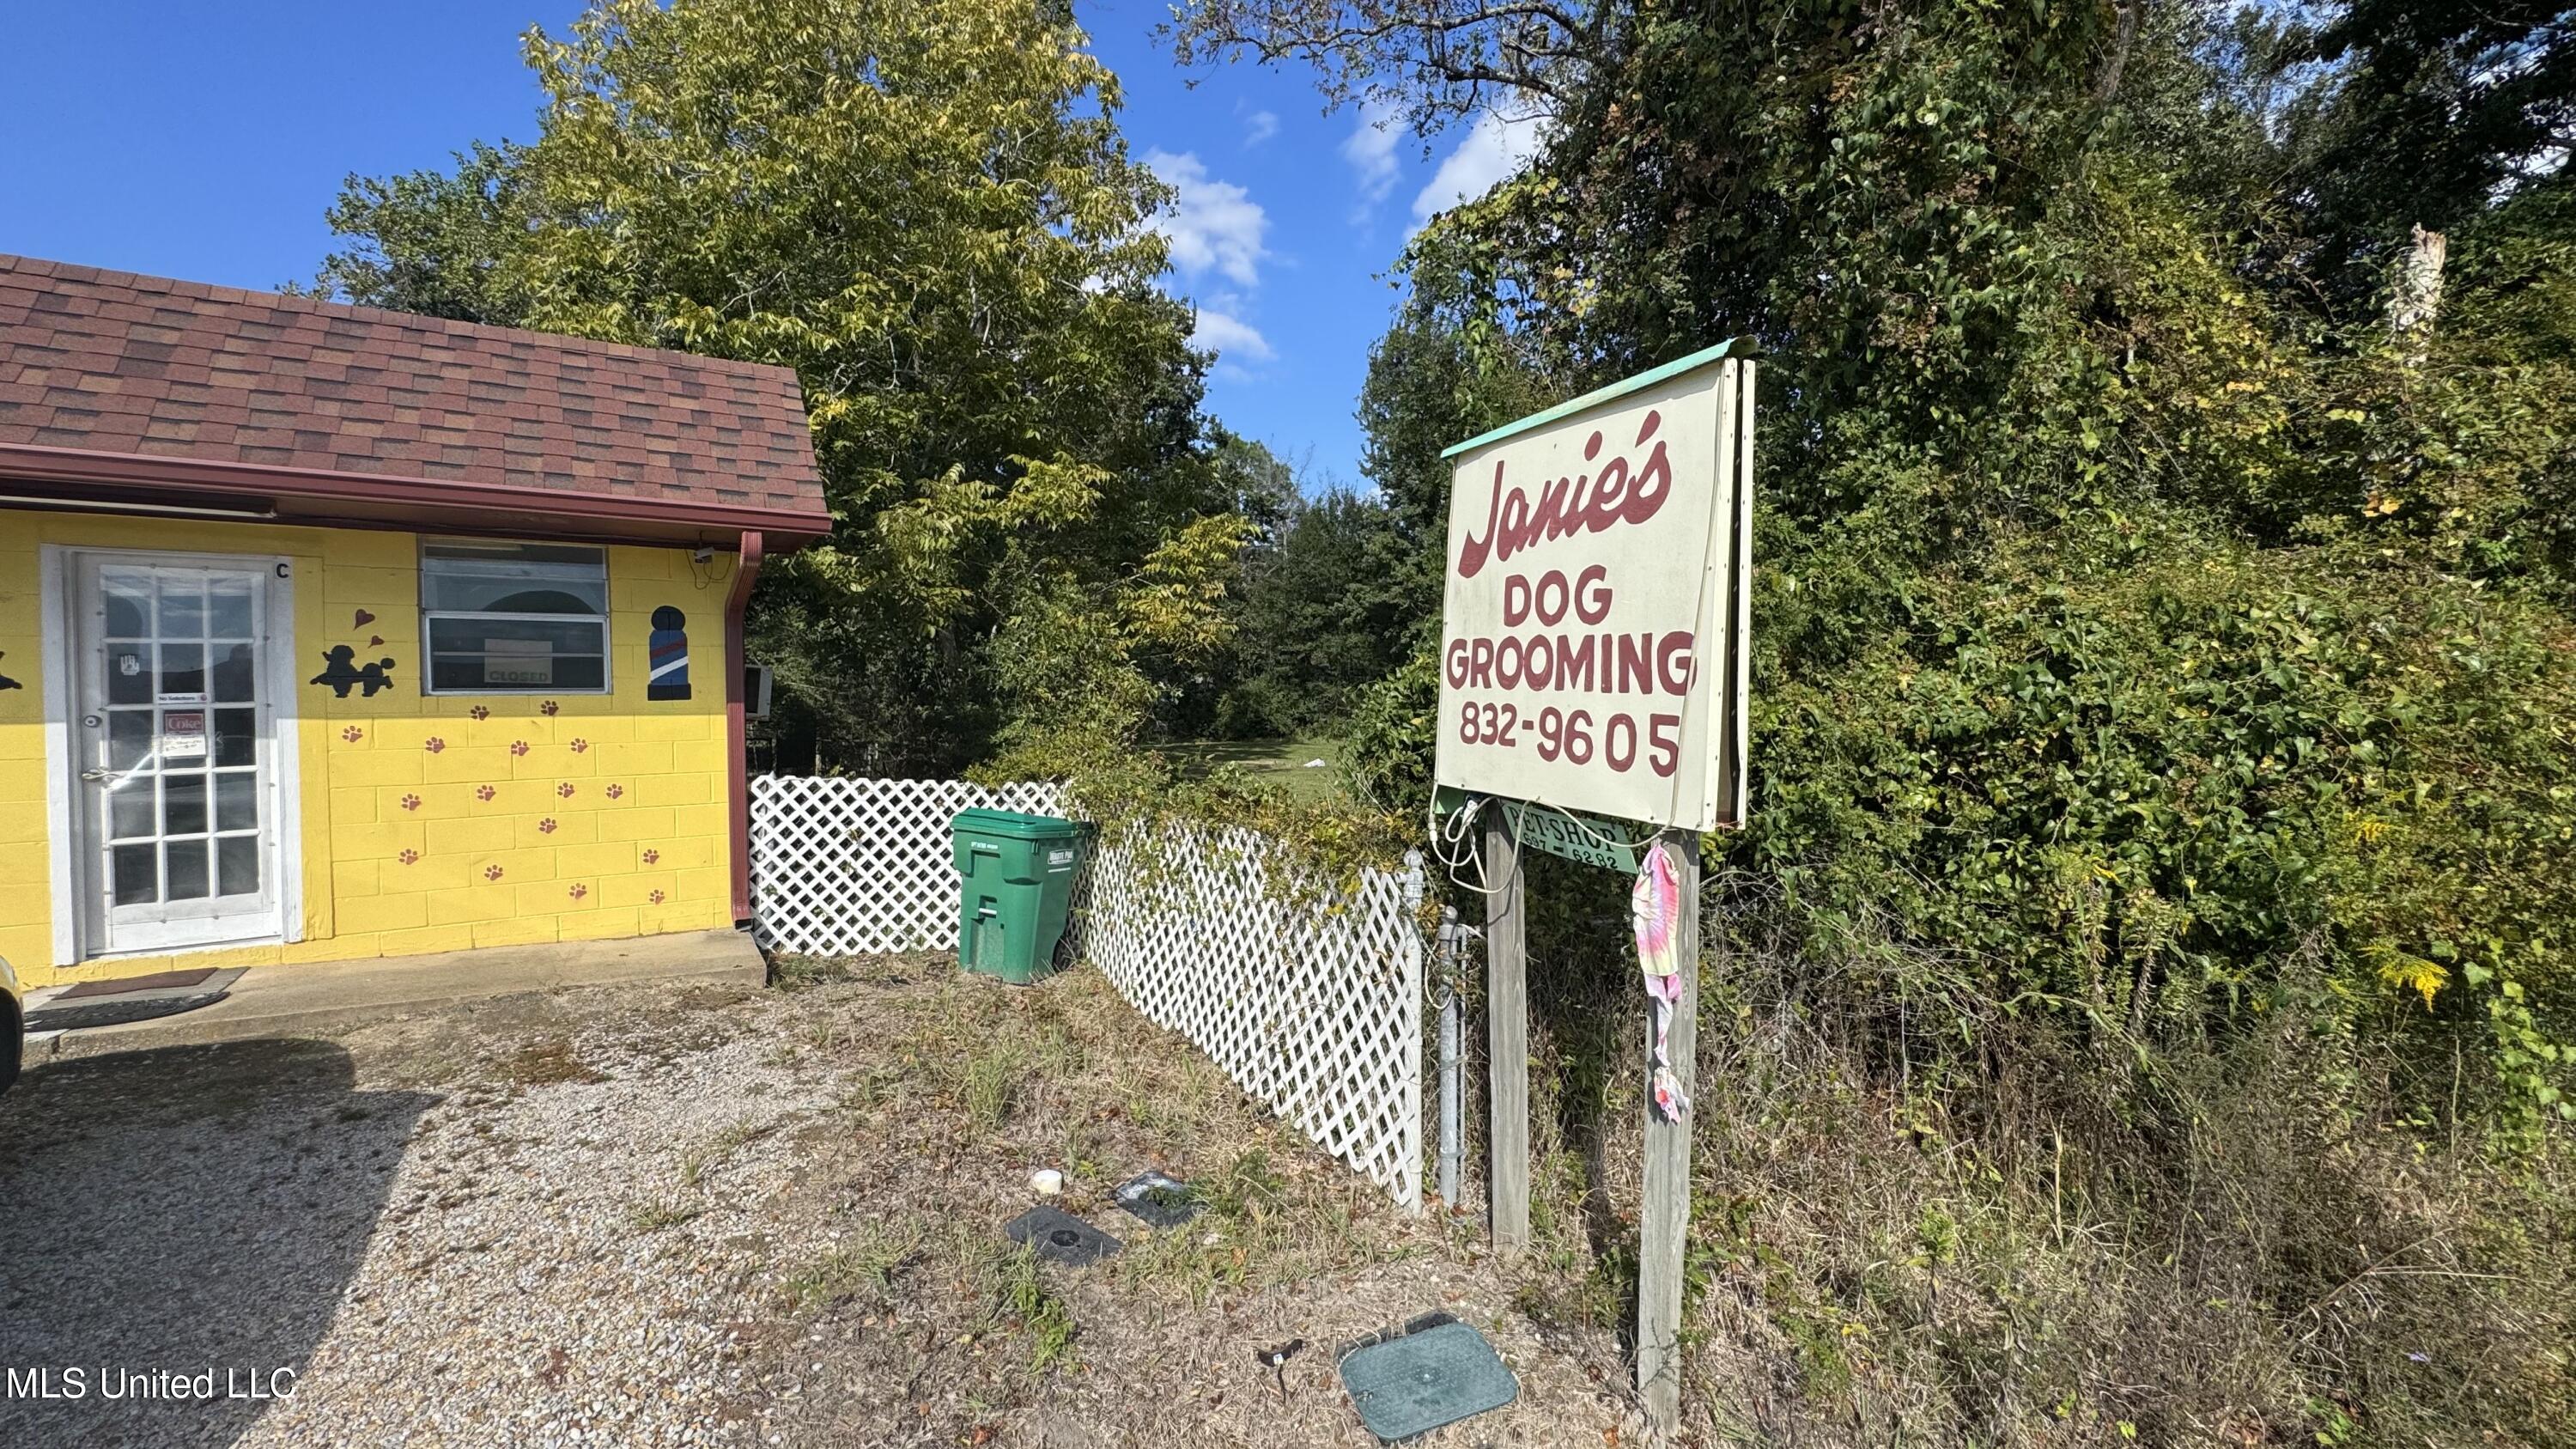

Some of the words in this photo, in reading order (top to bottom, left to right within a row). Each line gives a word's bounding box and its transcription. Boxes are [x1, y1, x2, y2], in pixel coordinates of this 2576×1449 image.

[1458, 410, 1672, 579] Janie's
[276, 563, 289, 578] C
[1504, 564, 1613, 627] DOG
[489, 671, 549, 682] CLOSED
[1446, 630, 1698, 697] GROOMING
[168, 717, 201, 729] Coke
[1460, 701, 1680, 777] 832-9605
